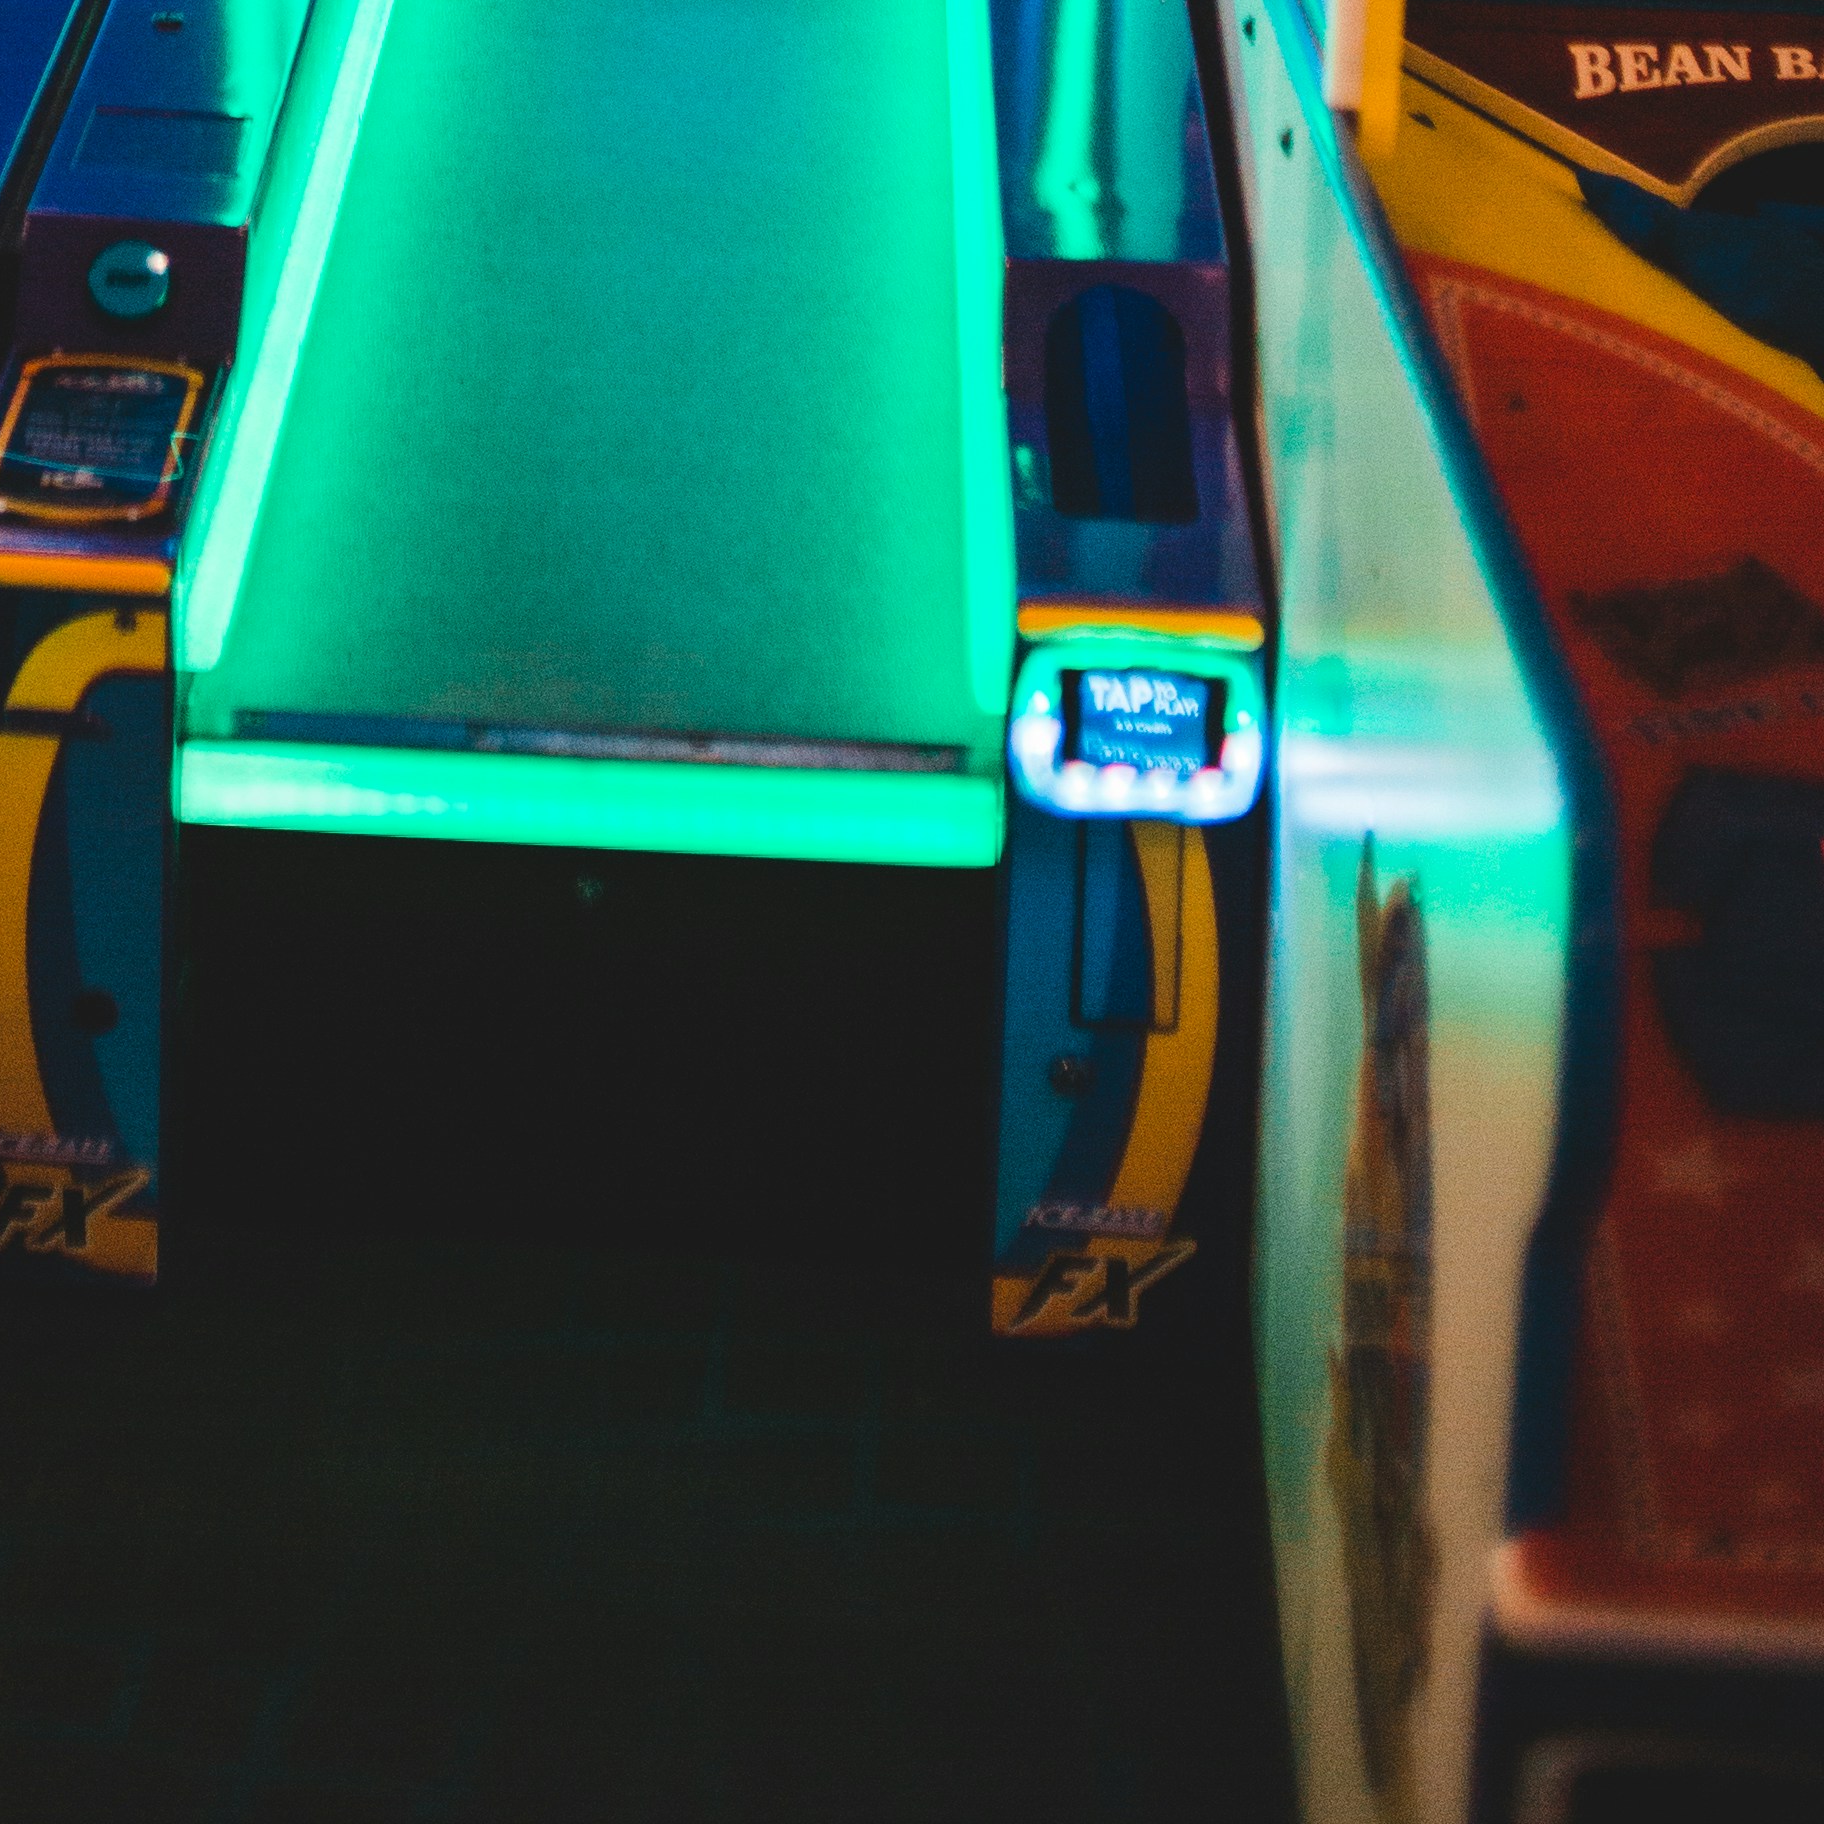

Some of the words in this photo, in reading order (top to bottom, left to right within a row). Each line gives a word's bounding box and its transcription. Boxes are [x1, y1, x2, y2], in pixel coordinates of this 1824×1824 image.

[1568, 42, 1752, 99] BEAN
[1770, 46, 1824, 81] B
[1087, 675, 1153, 713] TAP
[1008, 1238, 1197, 1336] FX
